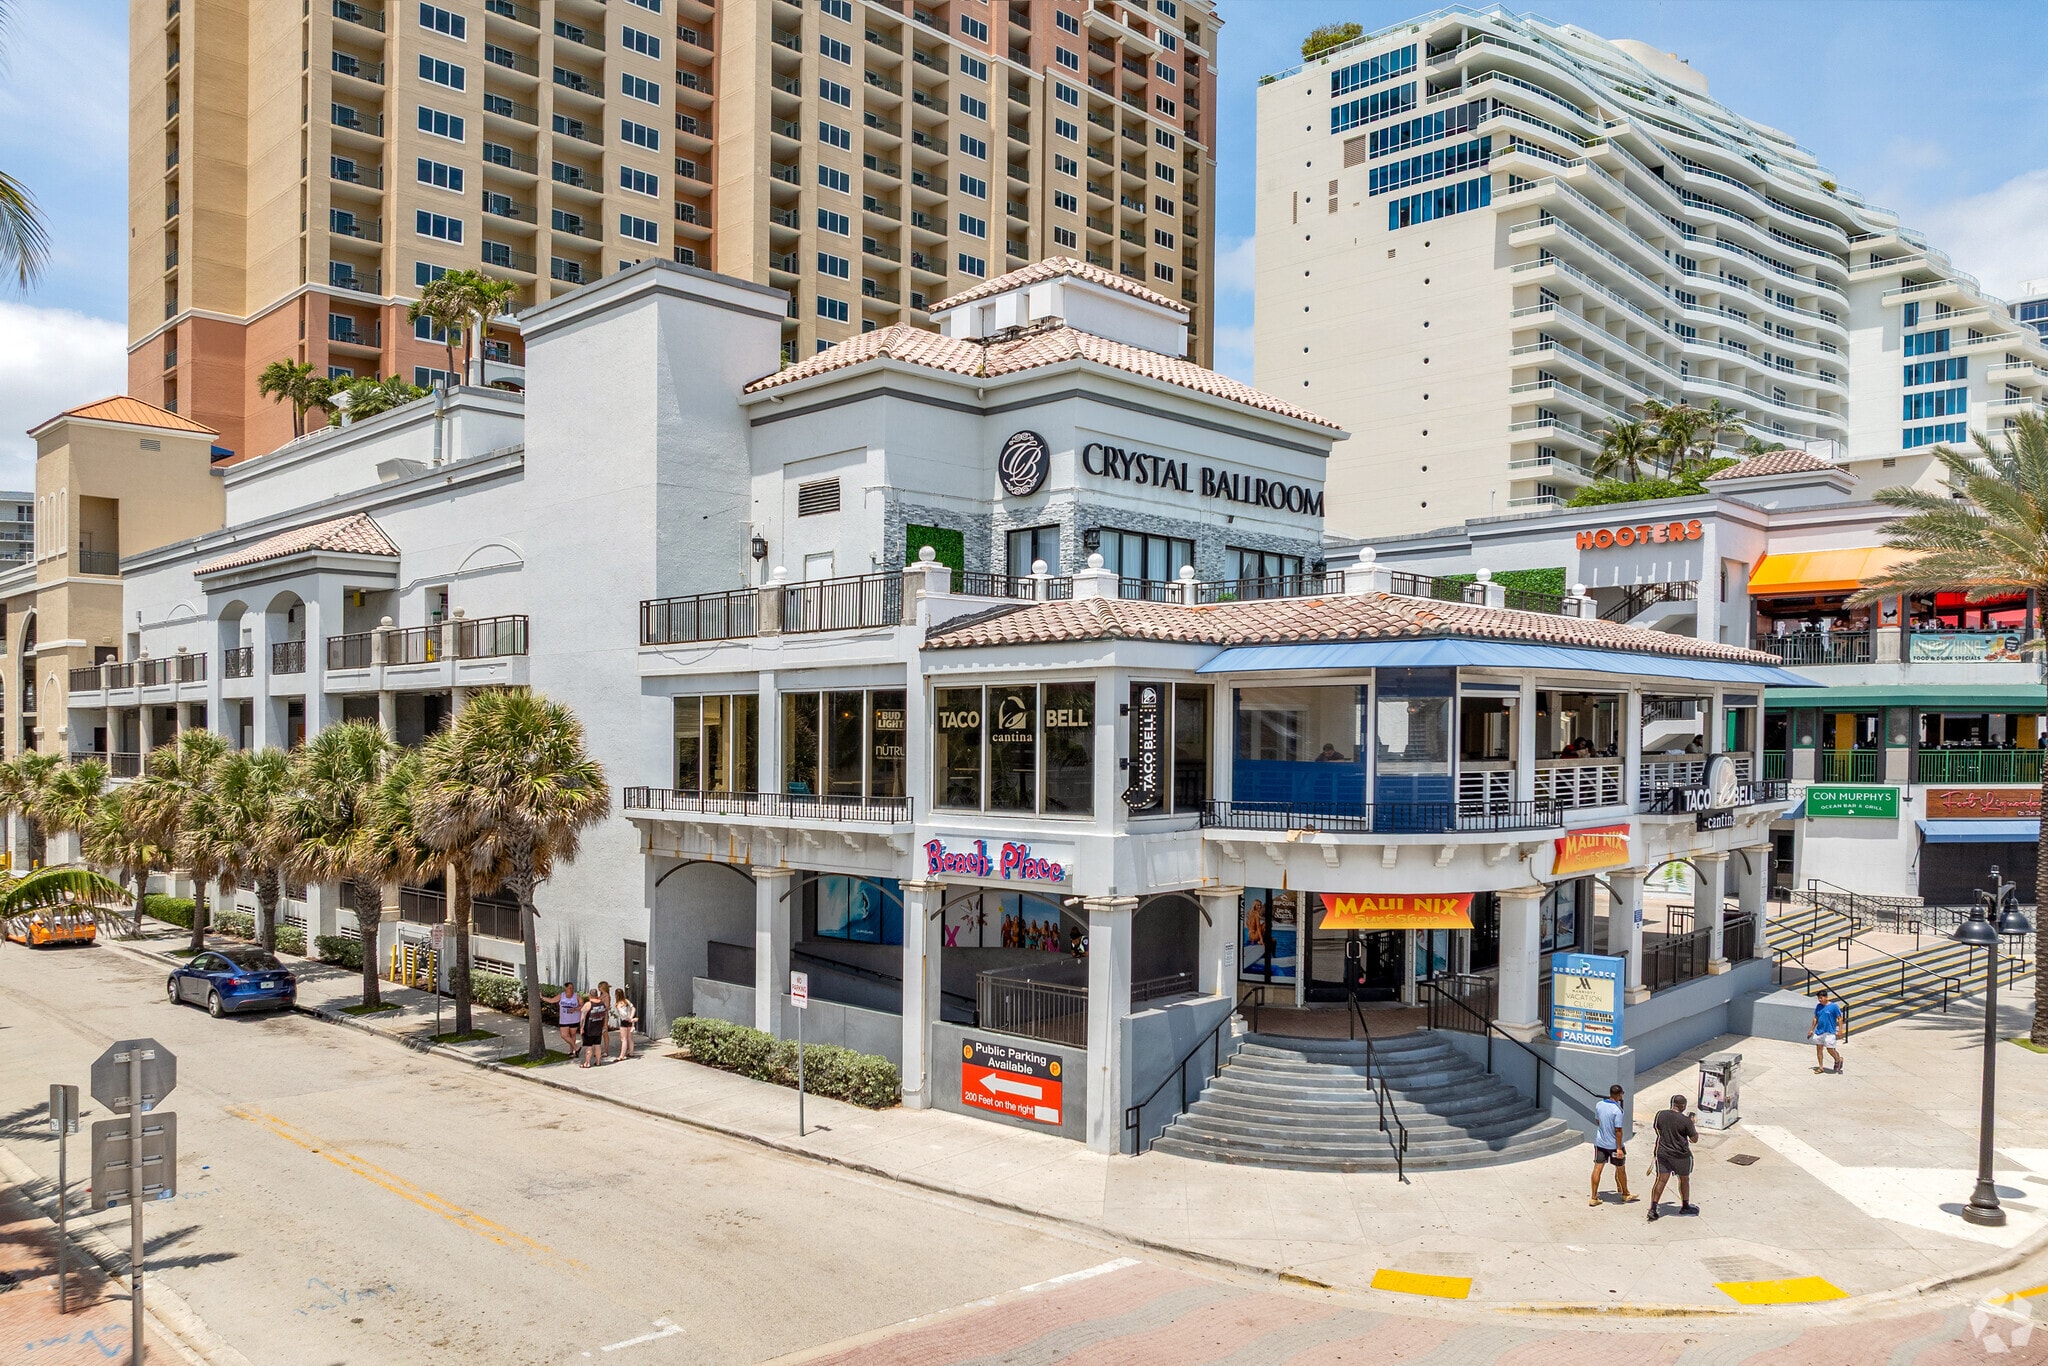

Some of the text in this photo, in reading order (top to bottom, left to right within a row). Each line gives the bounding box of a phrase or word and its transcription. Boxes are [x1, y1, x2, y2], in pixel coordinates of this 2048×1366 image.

[1082, 442, 1325, 518] CRYSTAL BALLROOM
[1576, 519, 1702, 551] HOOTERS
[1953, 640, 1981, 656] HOUR
[877, 719, 905, 729] LIGHT
[881, 711, 902, 720] BUD
[939, 709, 1089, 728] TACO BELL
[992, 731, 1033, 742] cantina
[1143, 714, 1154, 750] BELL
[1143, 752, 1154, 791] TACO
[1684, 784, 1756, 812] TACO BELL
[1813, 792, 1892, 801] CON MURPHY'S
[1940, 790, 1981, 813] Fort
[1707, 813, 1737, 829] cantina
[1565, 830, 1624, 860] MAUI NIX
[923, 838, 1065, 882] Beach Place
[1334, 897, 1460, 918] MAUI NIX
[1353, 913, 1440, 925] Surf Shop
[1565, 993, 1603, 1003] VACATION
[1573, 1000, 1594, 1008] CLUB
[1563, 1031, 1612, 1046] PARKING
[975, 1042, 1047, 1067] Public Parking
[988, 1057, 1033, 1075] Available
[965, 1091, 1034, 1115] 200 Feet on the right
